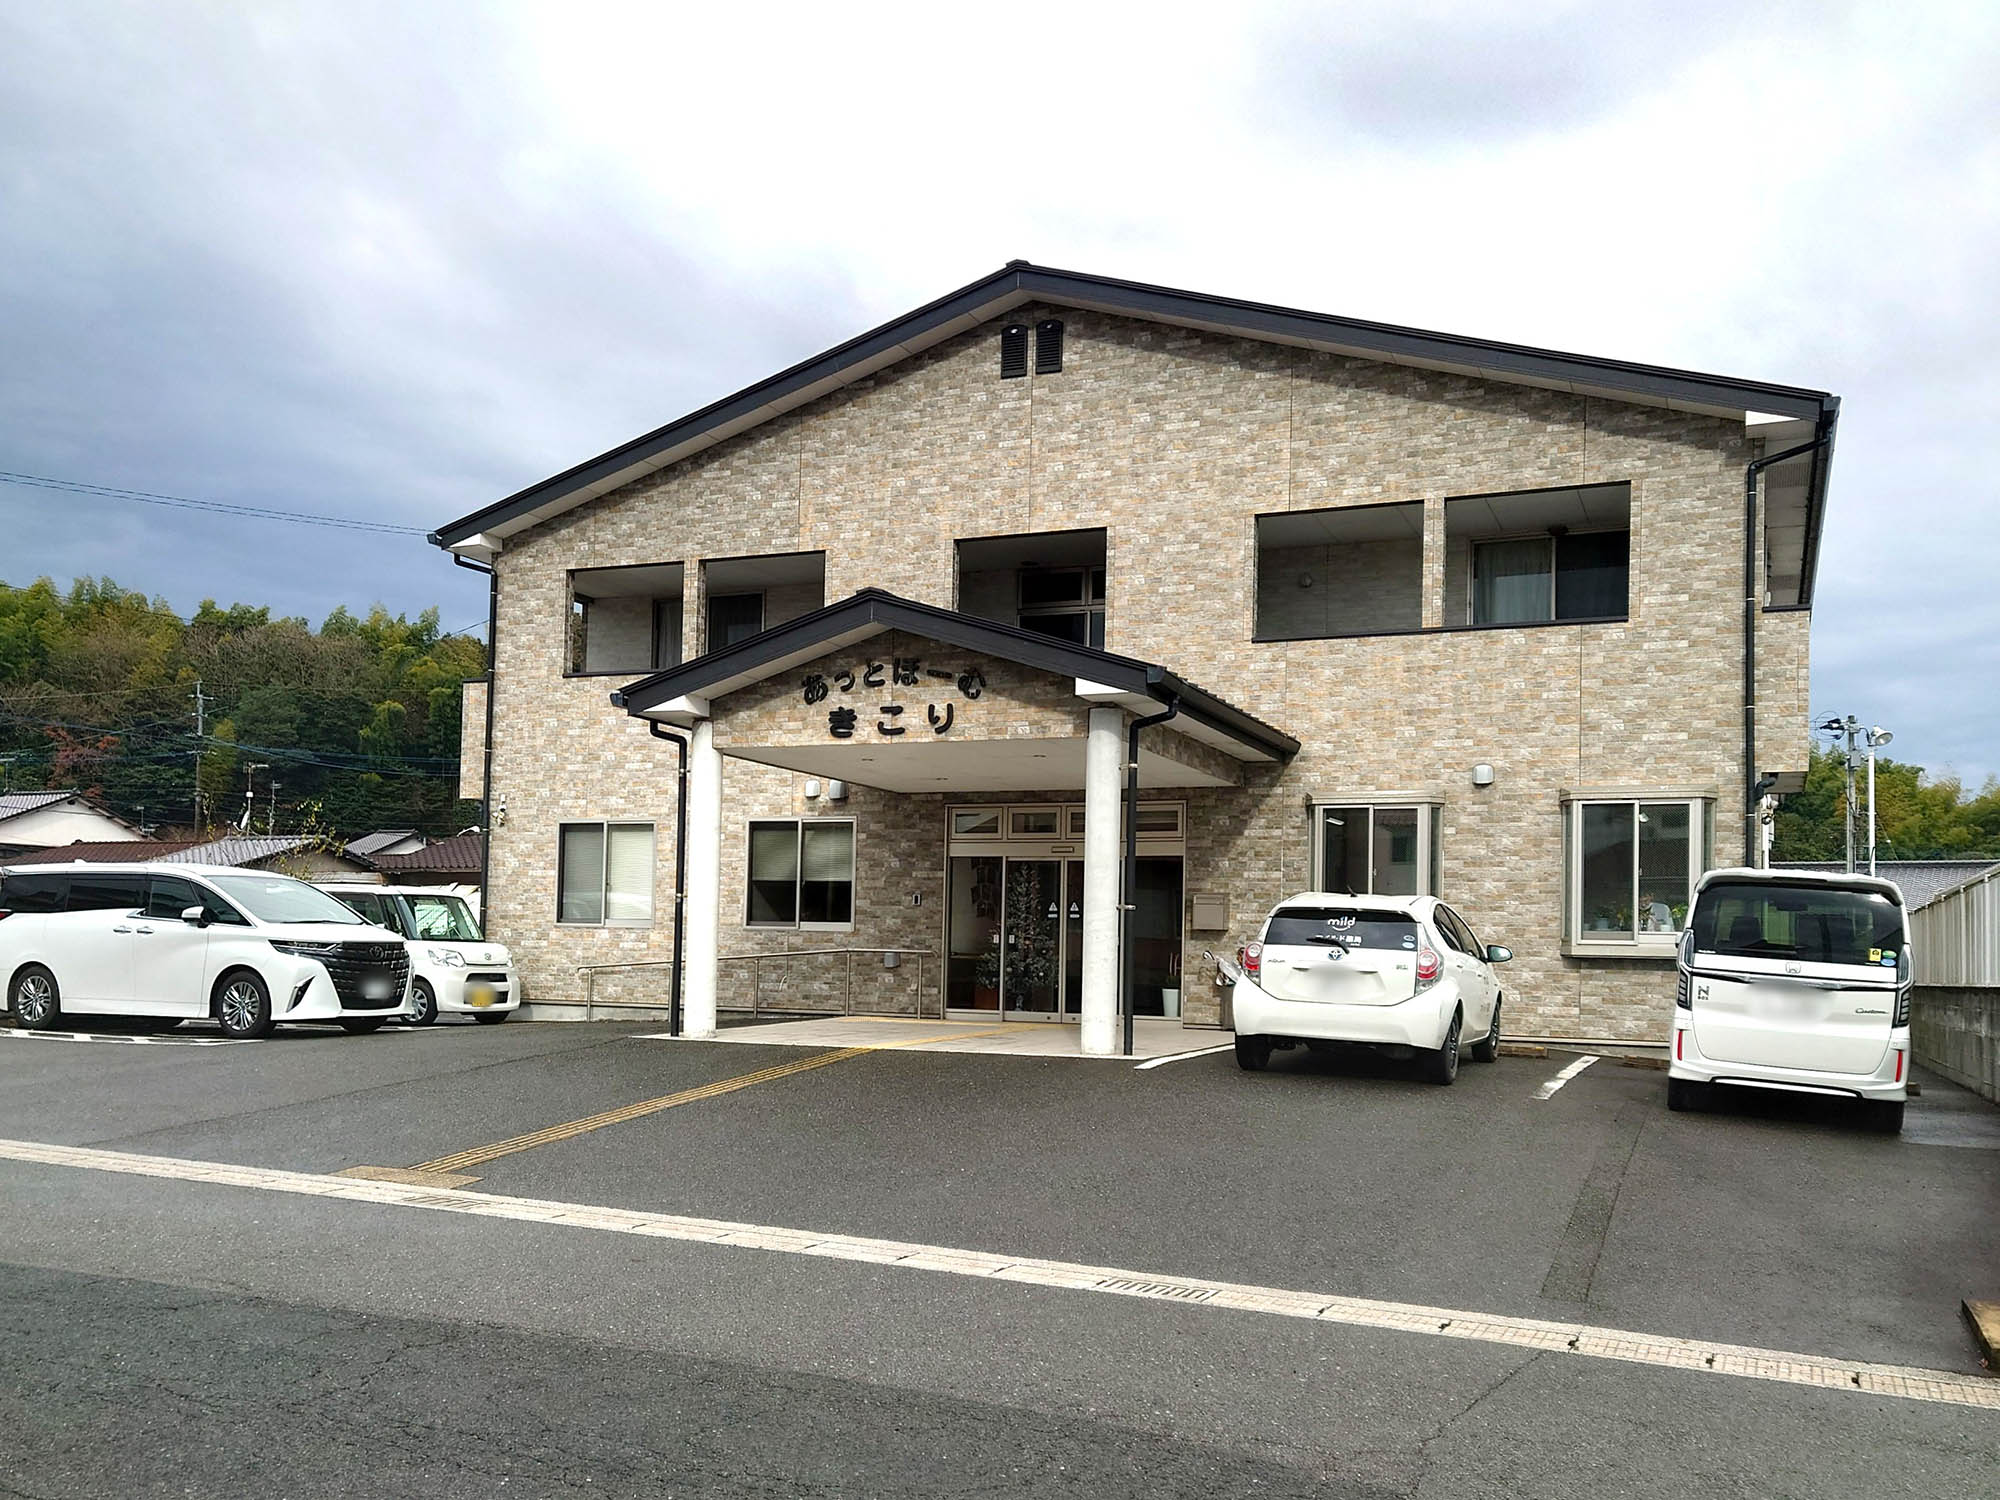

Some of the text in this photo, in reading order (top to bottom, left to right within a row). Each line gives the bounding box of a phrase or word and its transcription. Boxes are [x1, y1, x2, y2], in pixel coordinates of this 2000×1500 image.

[801, 657, 986, 705] あっとほーむ
[828, 703, 954, 738] きこり
[1327, 915, 1356, 927] mild
